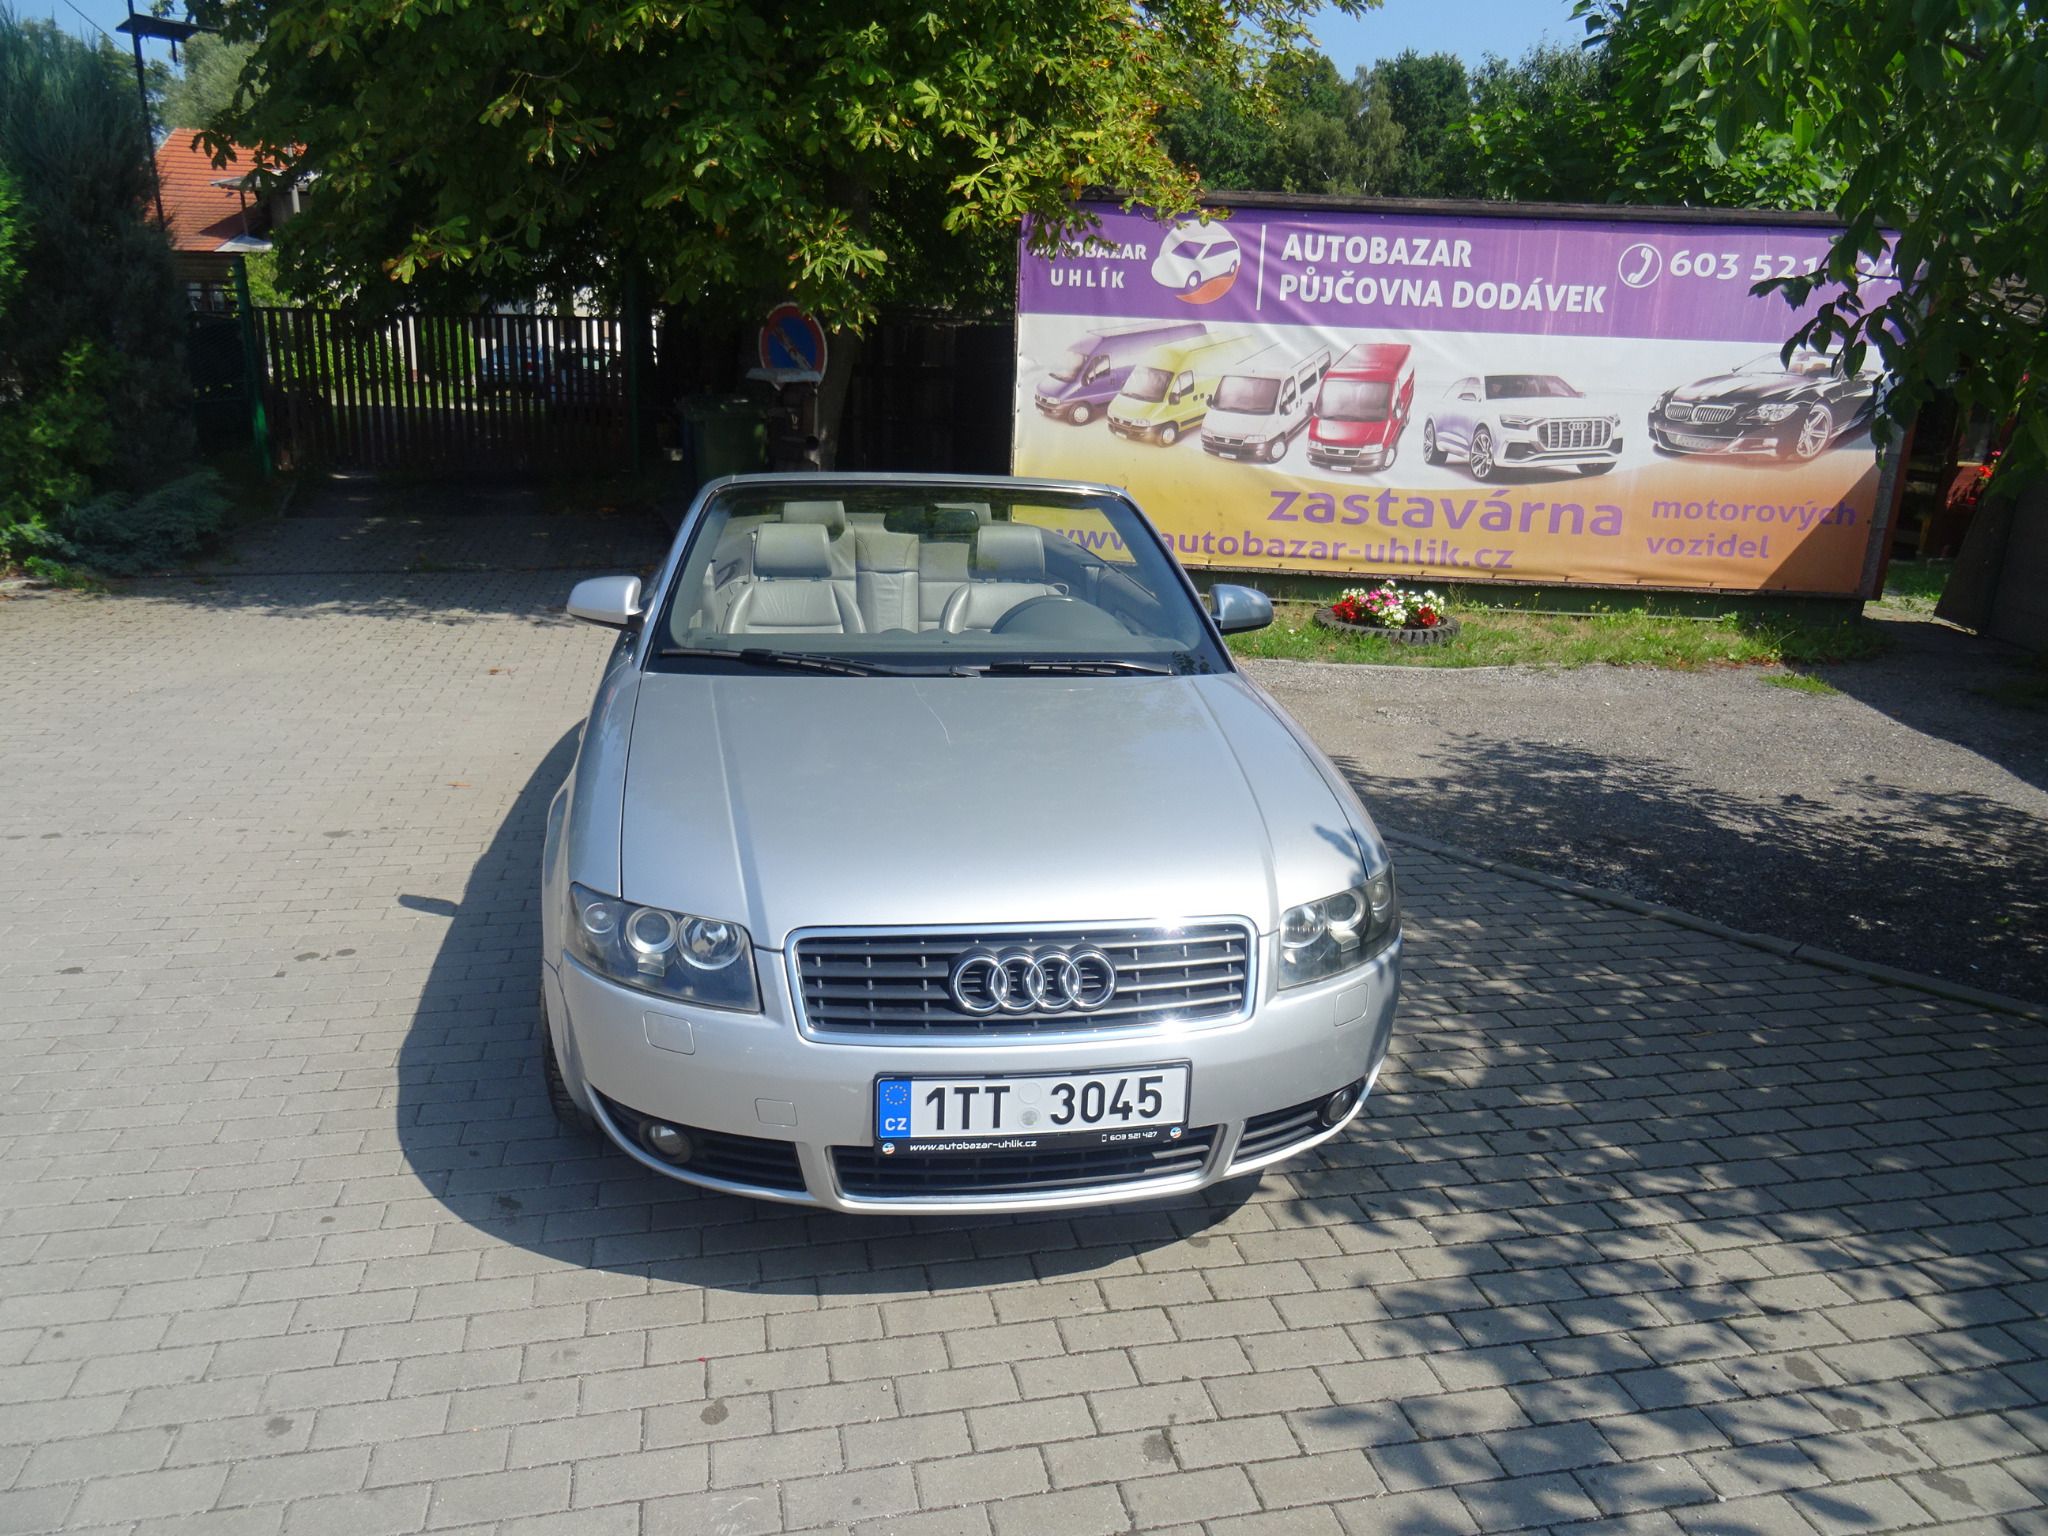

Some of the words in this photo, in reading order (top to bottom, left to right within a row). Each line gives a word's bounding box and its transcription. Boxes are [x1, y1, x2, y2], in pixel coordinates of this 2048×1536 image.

[1281, 233, 1472, 268] AUTOBAZAR
[1669, 250, 1740, 281] 603
[1750, 254, 1818, 282] 521
[1050, 266, 1125, 289] UHLÍK
[1278, 266, 1444, 308] PŮJČOVNA
[1452, 277, 1607, 313] DODÁVEK
[1267, 487, 1624, 537] zastavárna
[1651, 498, 1857, 532] motorových
[1646, 533, 1770, 559] vozidel
[925, 1085, 1011, 1130] 1TT
[1050, 1075, 1164, 1126] 3045
[884, 1117, 908, 1131] CZ
[1127, 1132, 1141, 1140] 521
[1142, 1130, 1158, 1138] 427
[909, 1139, 1038, 1152] www.autobazar-uhlik.cz
